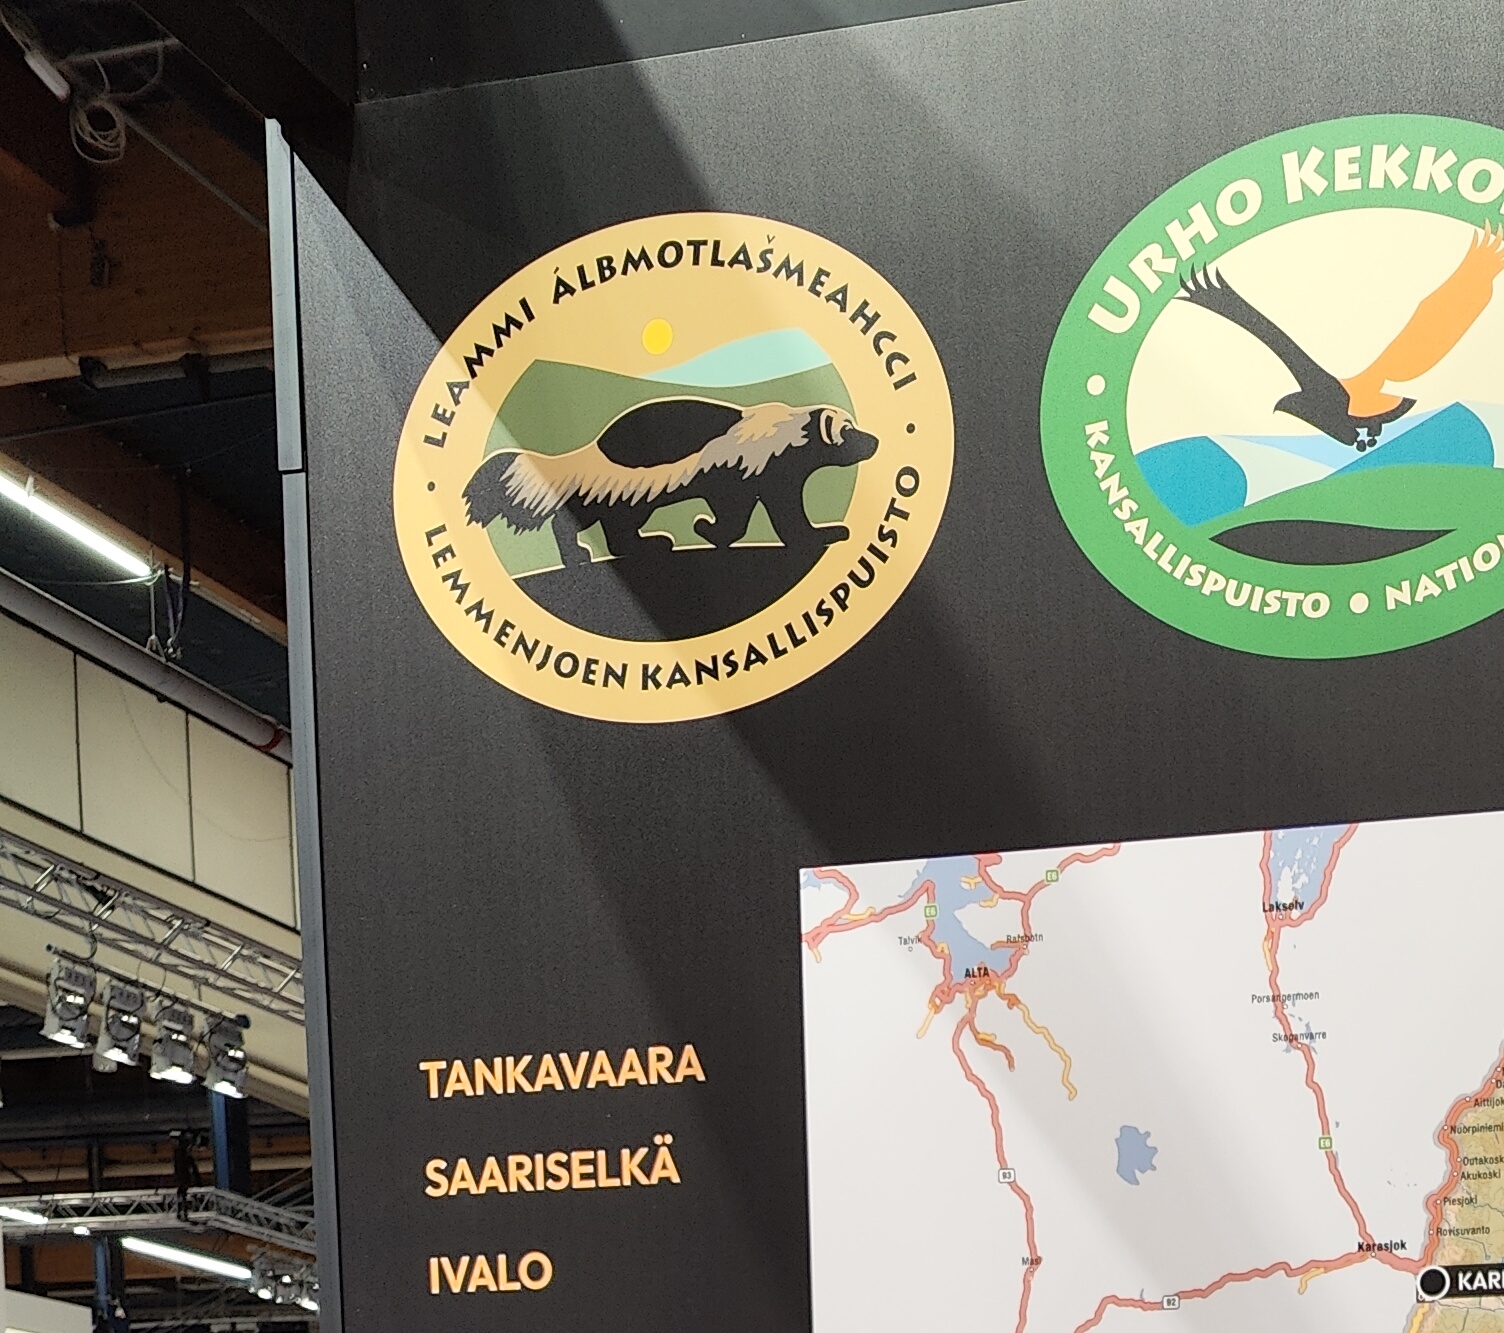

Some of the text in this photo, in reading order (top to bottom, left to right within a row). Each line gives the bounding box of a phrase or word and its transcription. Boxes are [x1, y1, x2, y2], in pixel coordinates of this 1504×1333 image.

[1087, 178, 1263, 335] URHO
[424, 235, 917, 447] LEAMMI ÁLBMOTLAŠMEAHCCI
[1084, 420, 1330, 619] KANSALLISPUISTO
[425, 465, 921, 690] LEMMENJOEN KANSALLISPUISTO
[964, 966, 990, 979] ALTA
[419, 1044, 706, 1099] TANKAVAARA
[424, 1132, 681, 1198] SAARISELKÄ
[429, 1251, 553, 1295] IVALO
[1357, 1239, 1407, 1253] Karasjok
